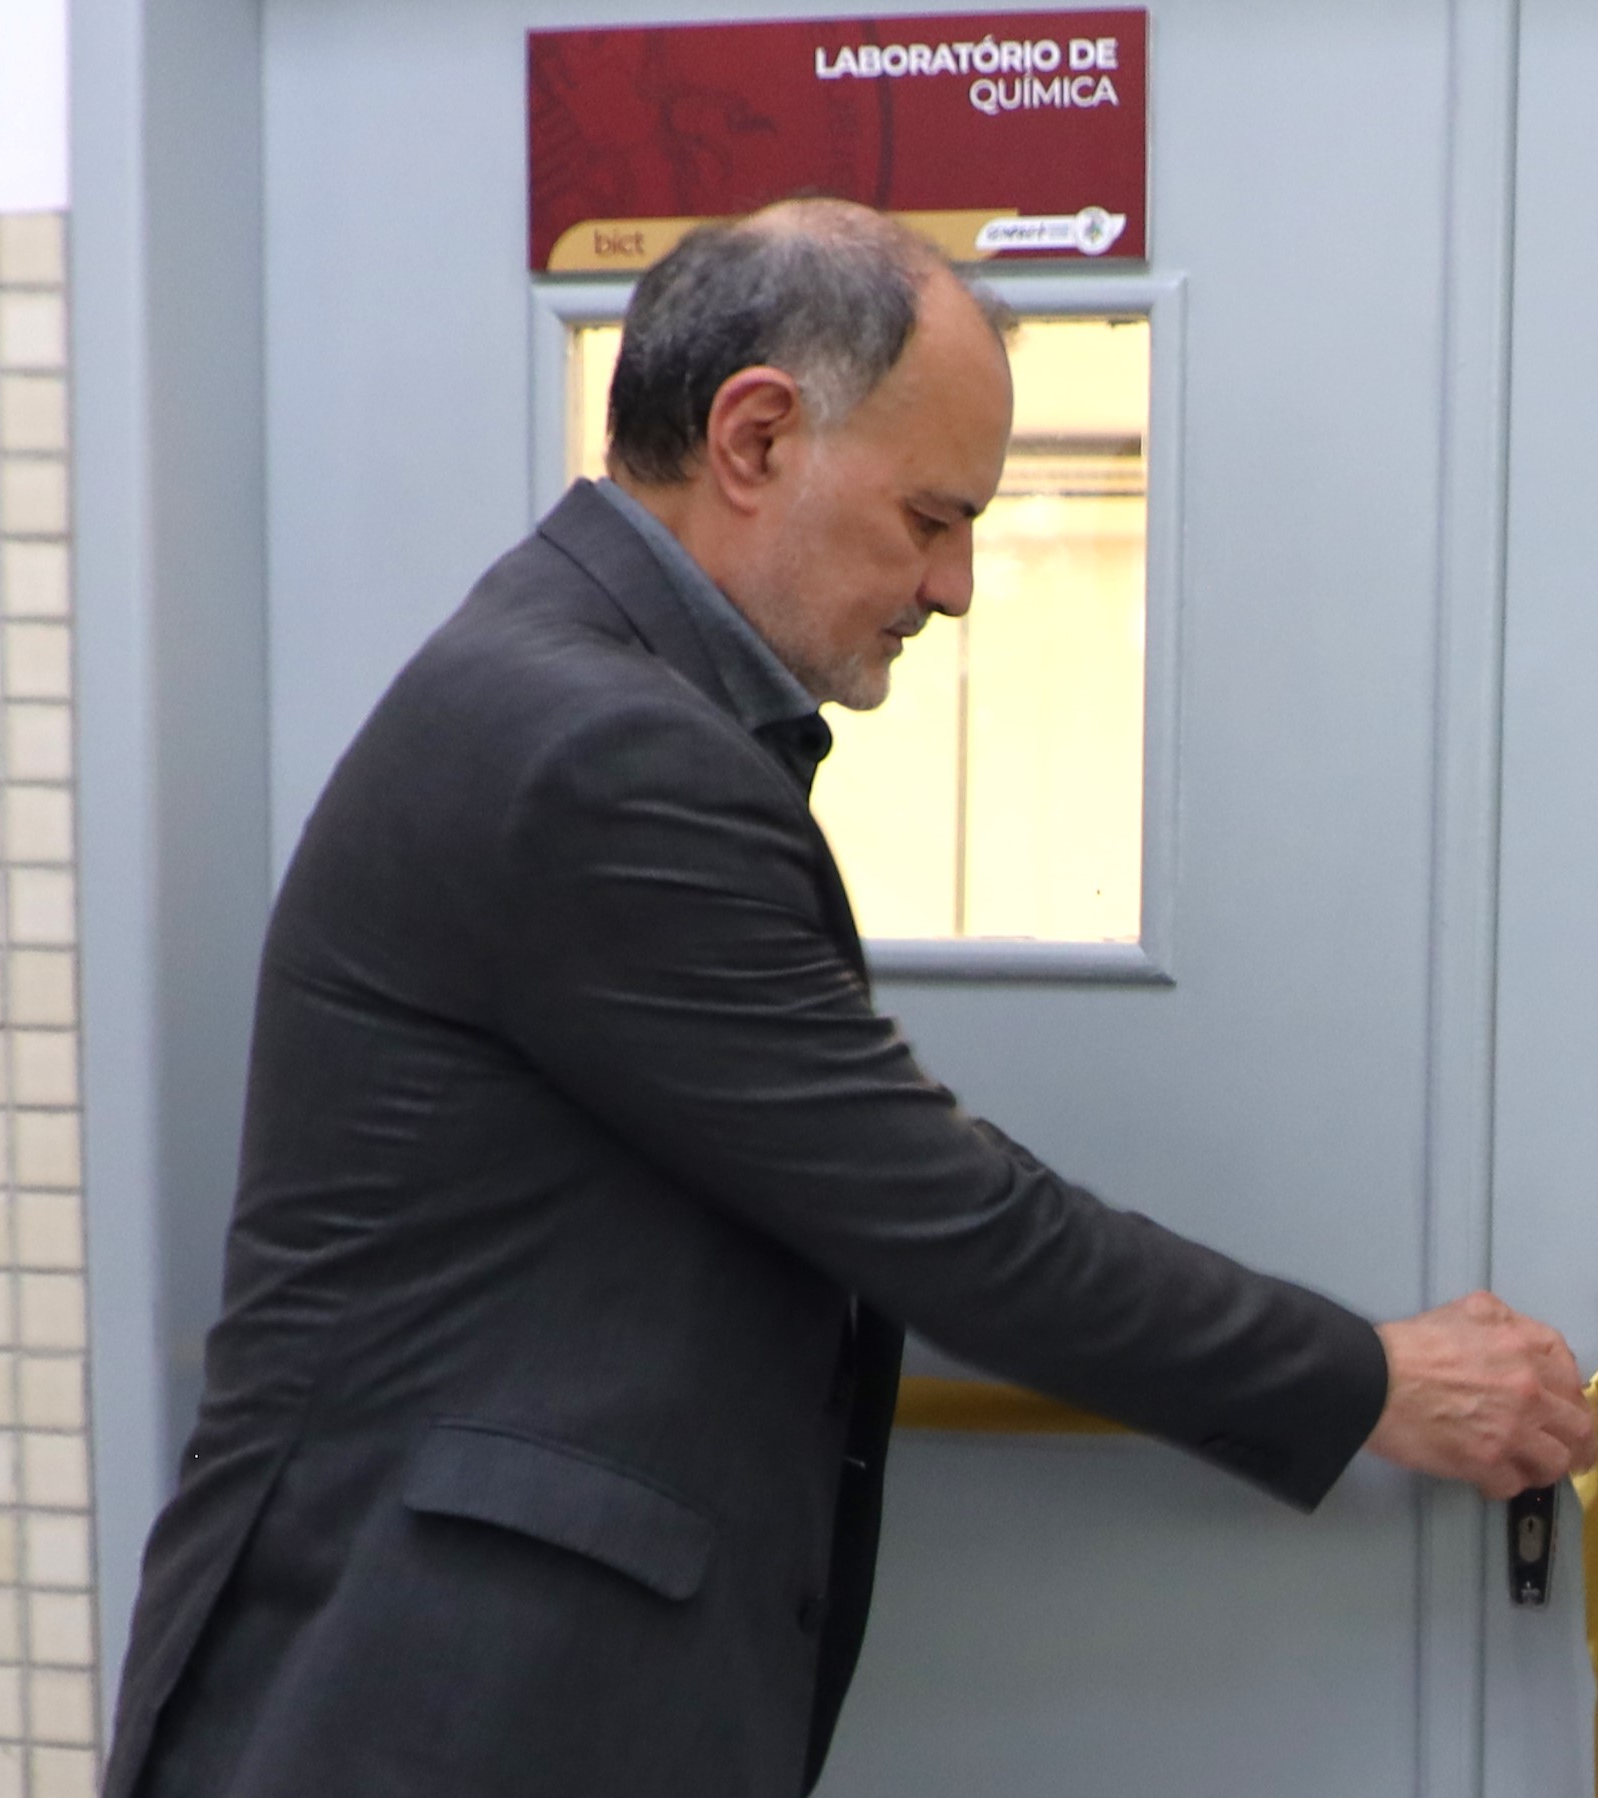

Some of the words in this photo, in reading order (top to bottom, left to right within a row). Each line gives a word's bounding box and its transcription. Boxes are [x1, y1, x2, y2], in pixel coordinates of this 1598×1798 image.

[814, 34, 1061, 79] LABORATÓRIO
[1068, 37, 1118, 71] DE
[968, 71, 1120, 115] QUÍMICA
